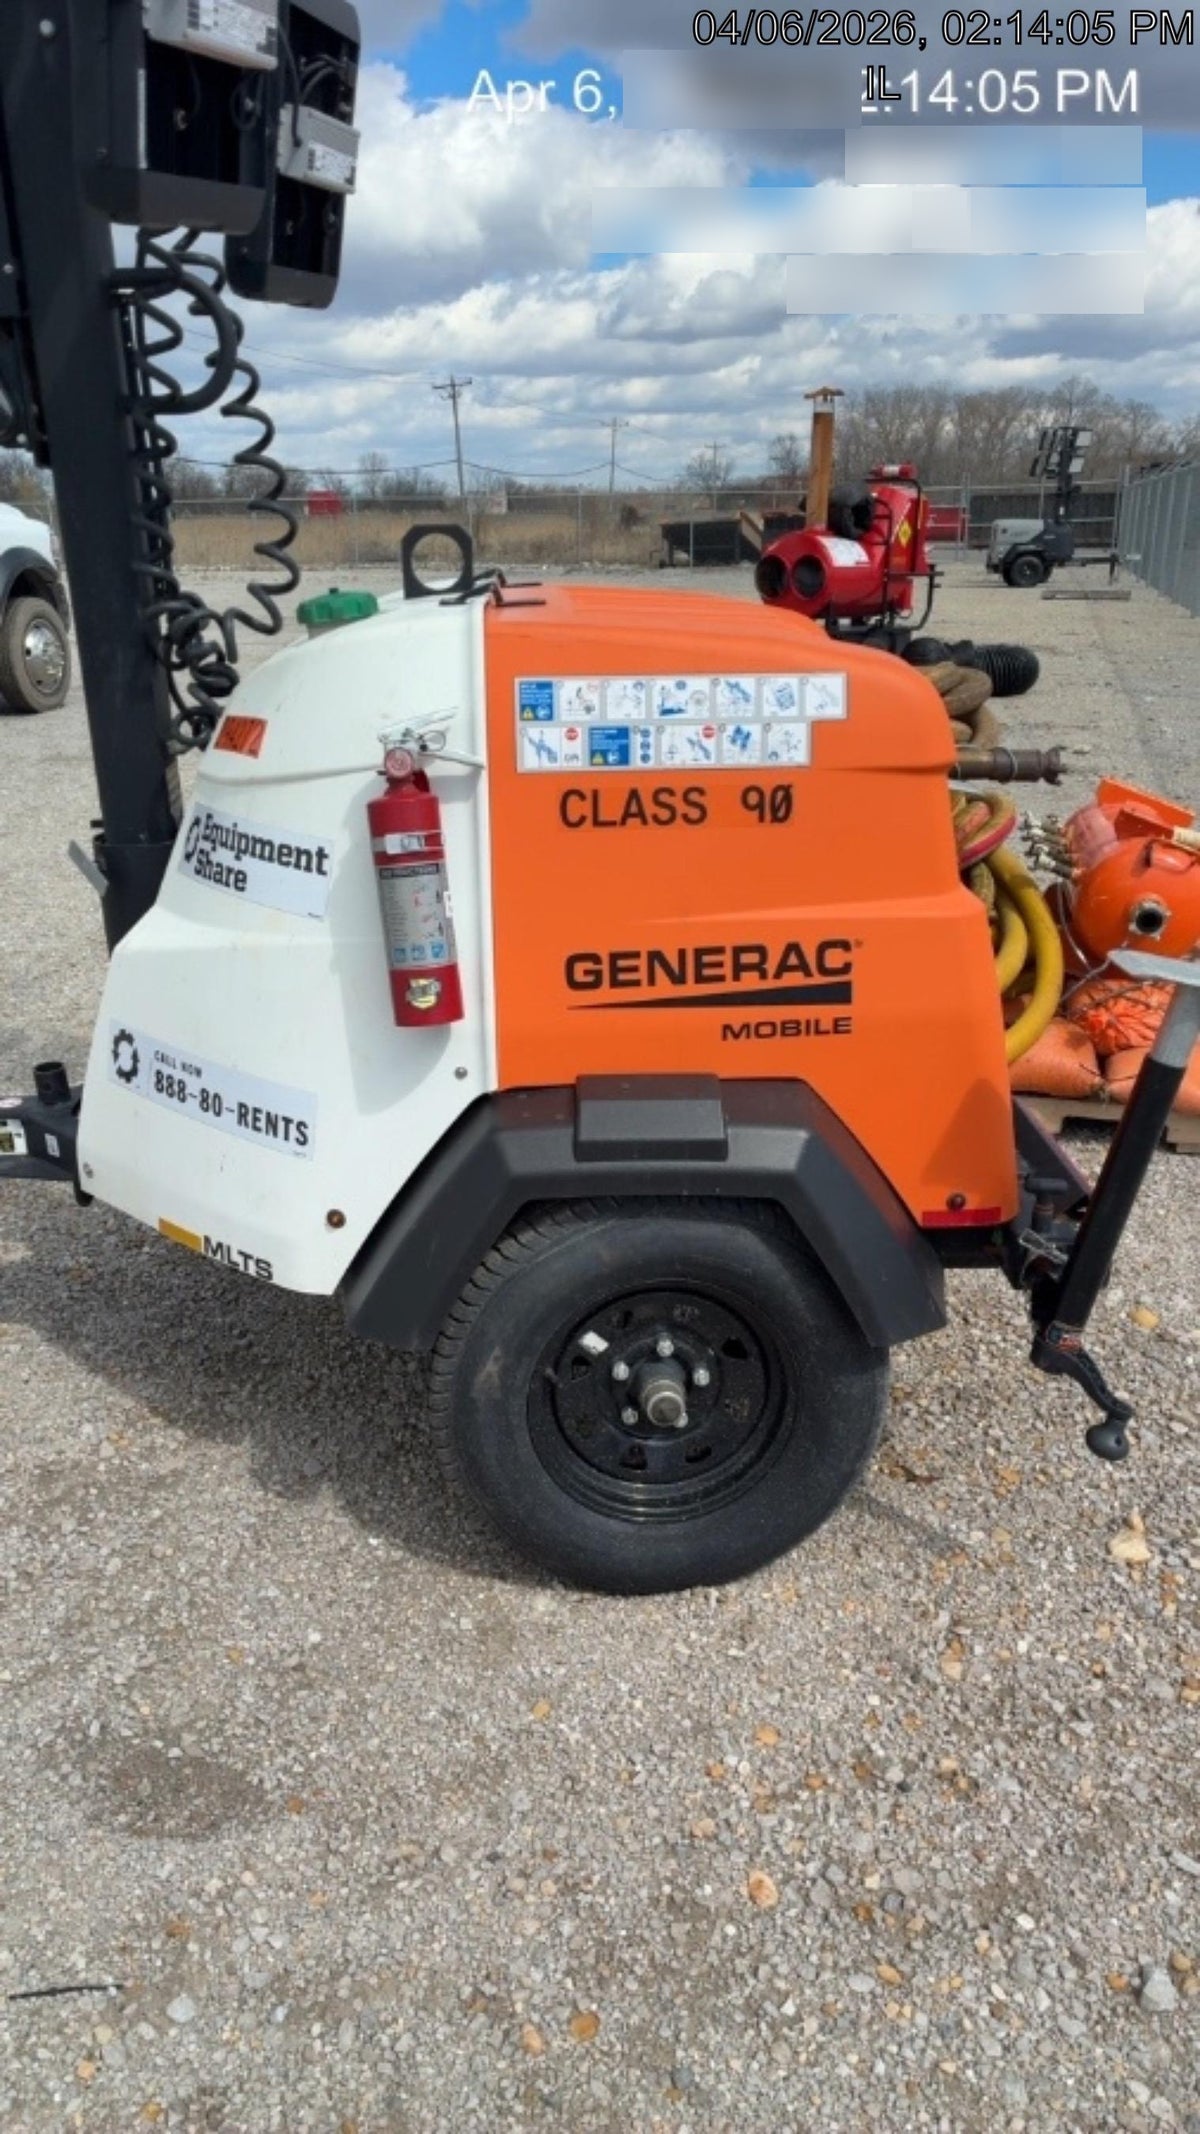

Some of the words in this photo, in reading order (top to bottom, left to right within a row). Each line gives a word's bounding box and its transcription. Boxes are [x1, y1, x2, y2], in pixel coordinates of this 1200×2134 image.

[559, 786, 708, 828] CLASS
[201, 812, 329, 876] Equipment
[194, 849, 248, 892] Share
[565, 939, 853, 991] GENERAC
[721, 1017, 853, 1041] MOBILE
[154, 1050, 177, 1070] CALL
[180, 1062, 203, 1078] NOW
[154, 1069, 309, 1146] 888-80-RENTS
[202, 1235, 273, 1281] MLTS
